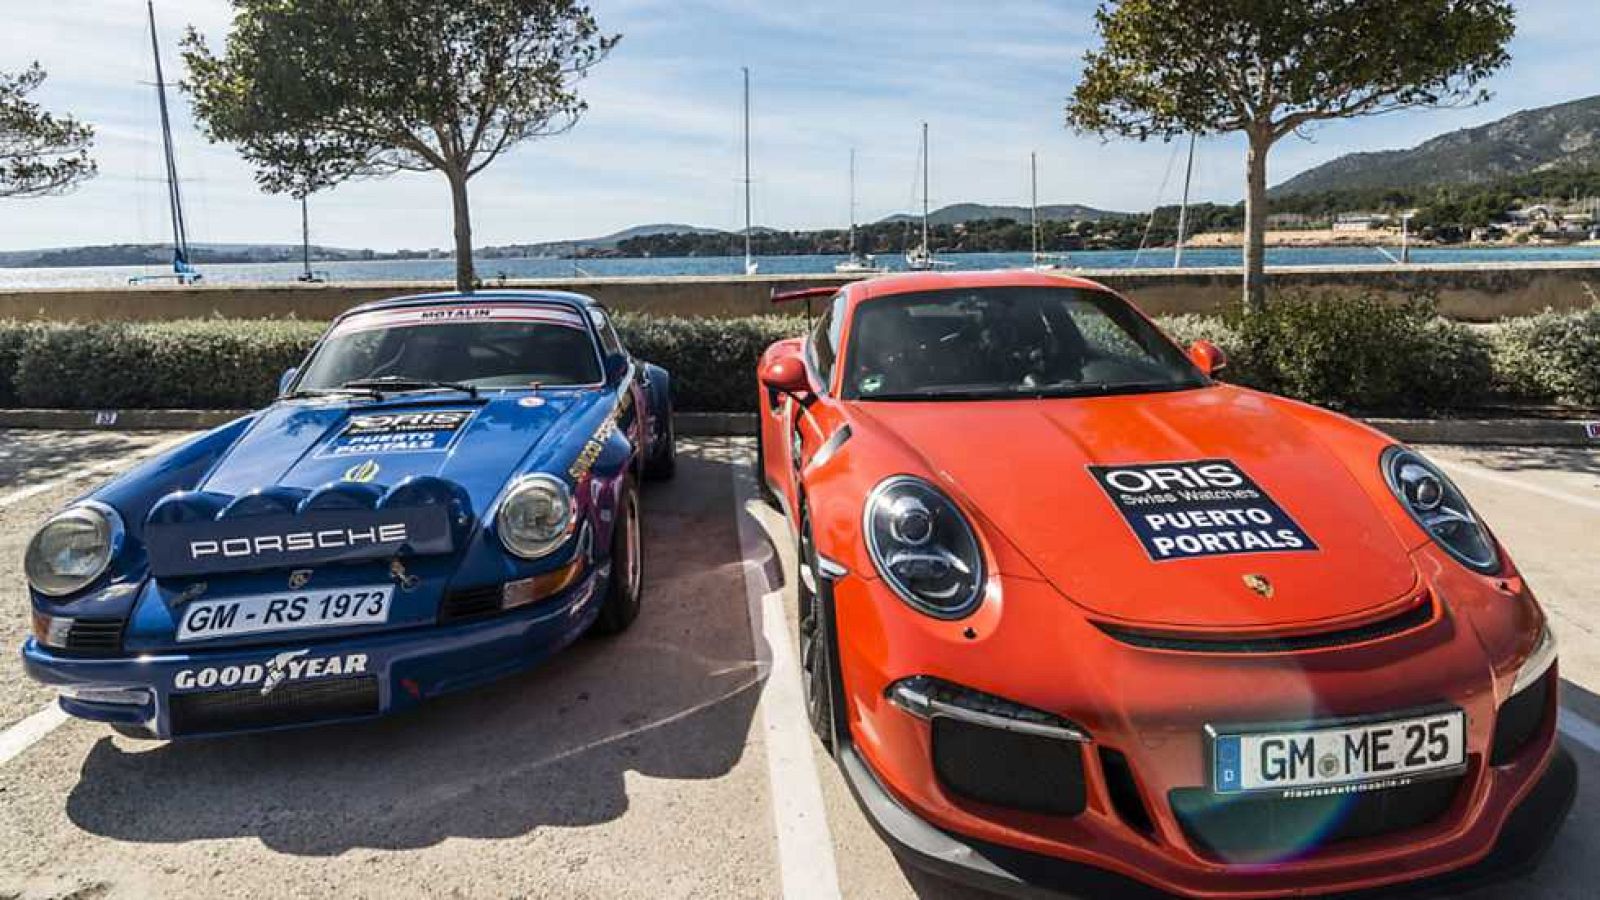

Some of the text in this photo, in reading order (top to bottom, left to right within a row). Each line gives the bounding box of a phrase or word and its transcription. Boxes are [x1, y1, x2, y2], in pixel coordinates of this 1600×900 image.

[1105, 463, 1243, 492] ORIS
[1119, 488, 1260, 505] Swiss Watches
[1145, 507, 1273, 532] PUERTO
[190, 523, 407, 559] PORSCHE
[1151, 528, 1304, 556] PORTALS
[186, 603, 241, 633] GM
[263, 596, 308, 625] RS
[319, 591, 385, 619] 1973
[1259, 719, 1450, 781] GM ME 25
